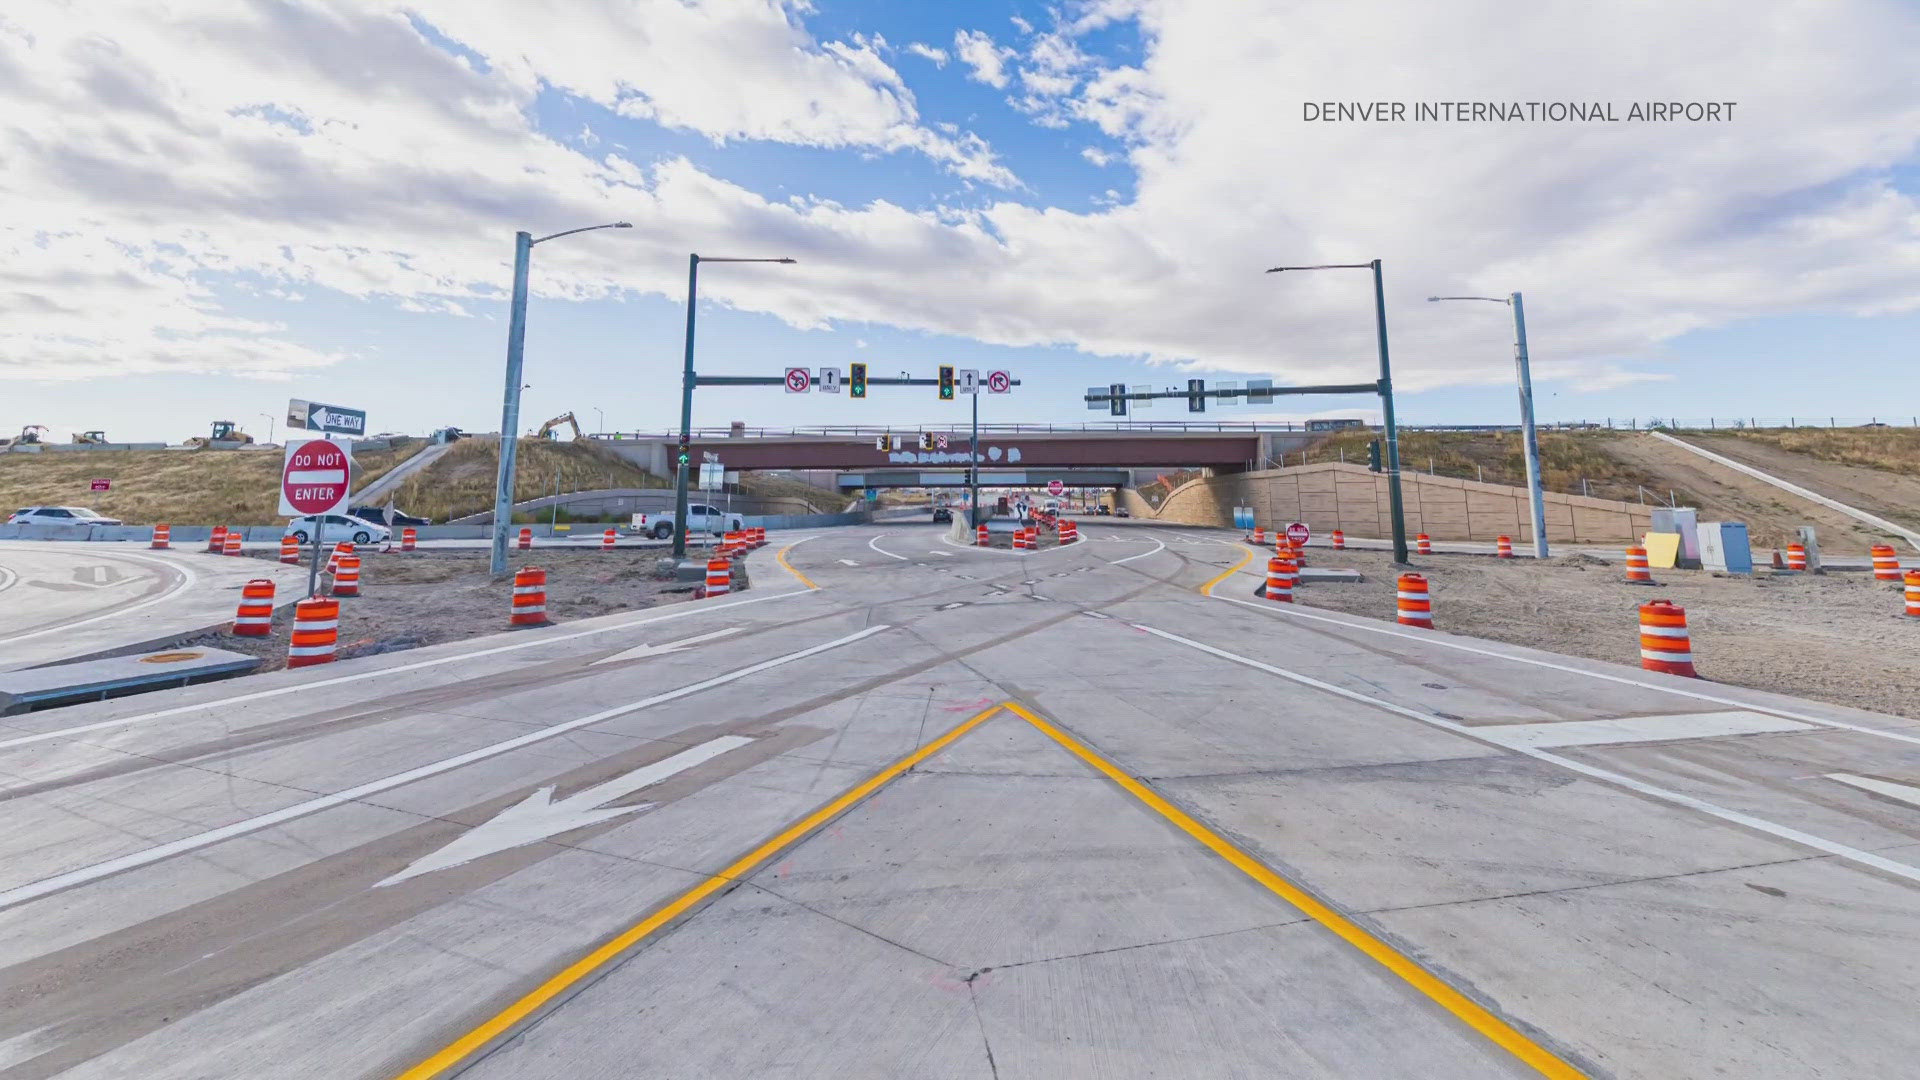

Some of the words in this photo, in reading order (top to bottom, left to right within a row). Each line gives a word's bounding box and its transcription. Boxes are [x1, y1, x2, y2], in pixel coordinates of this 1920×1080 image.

[325, 413, 342, 426] ONE
[344, 415, 360, 427] WAY
[295, 455, 311, 466] DO
[317, 453, 341, 466] NOT
[295, 487, 334, 500] ENTER
